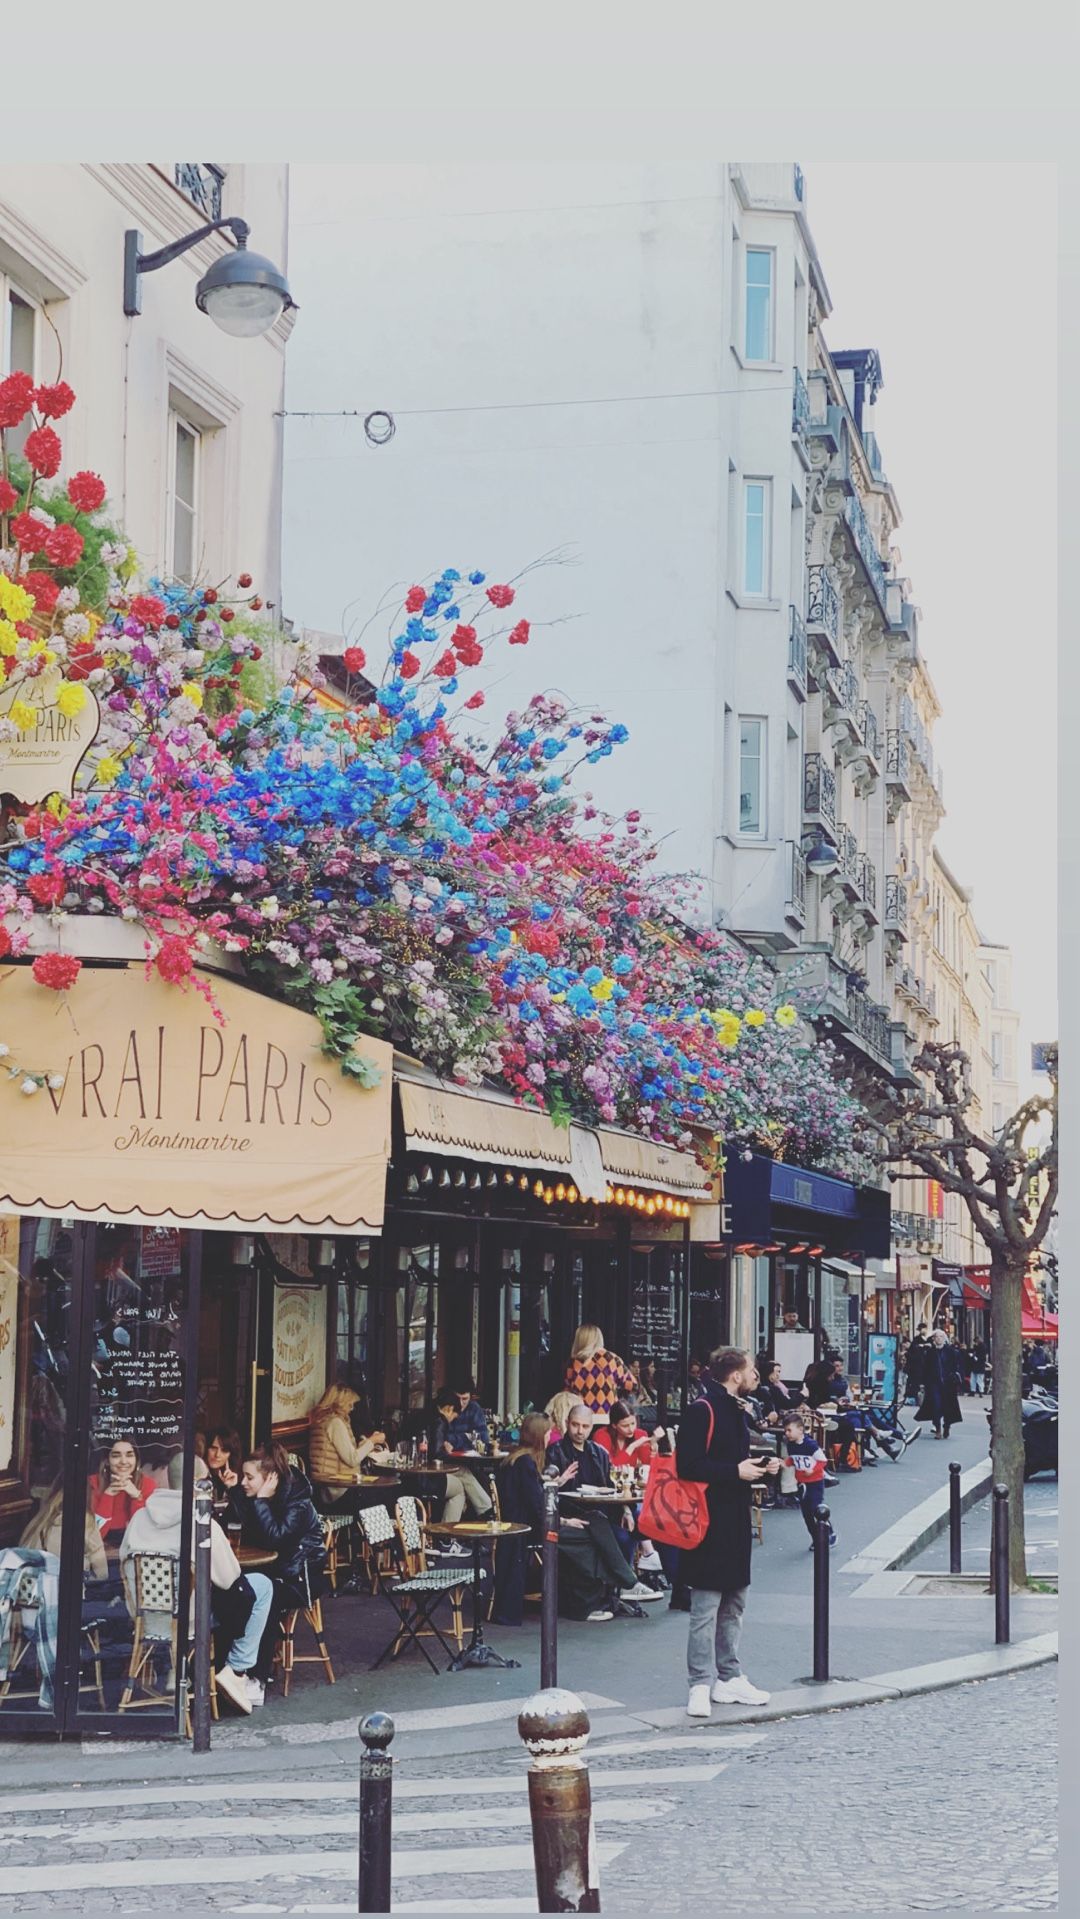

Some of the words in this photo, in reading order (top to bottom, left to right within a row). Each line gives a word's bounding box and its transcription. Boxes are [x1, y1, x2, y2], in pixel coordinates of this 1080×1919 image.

[35, 709, 81, 742] PARIS
[6, 747, 61, 760] Montmartre
[44, 1026, 164, 1120] VRAI
[195, 1026, 333, 1126] PARIS
[114, 1124, 253, 1153] Montmartre
